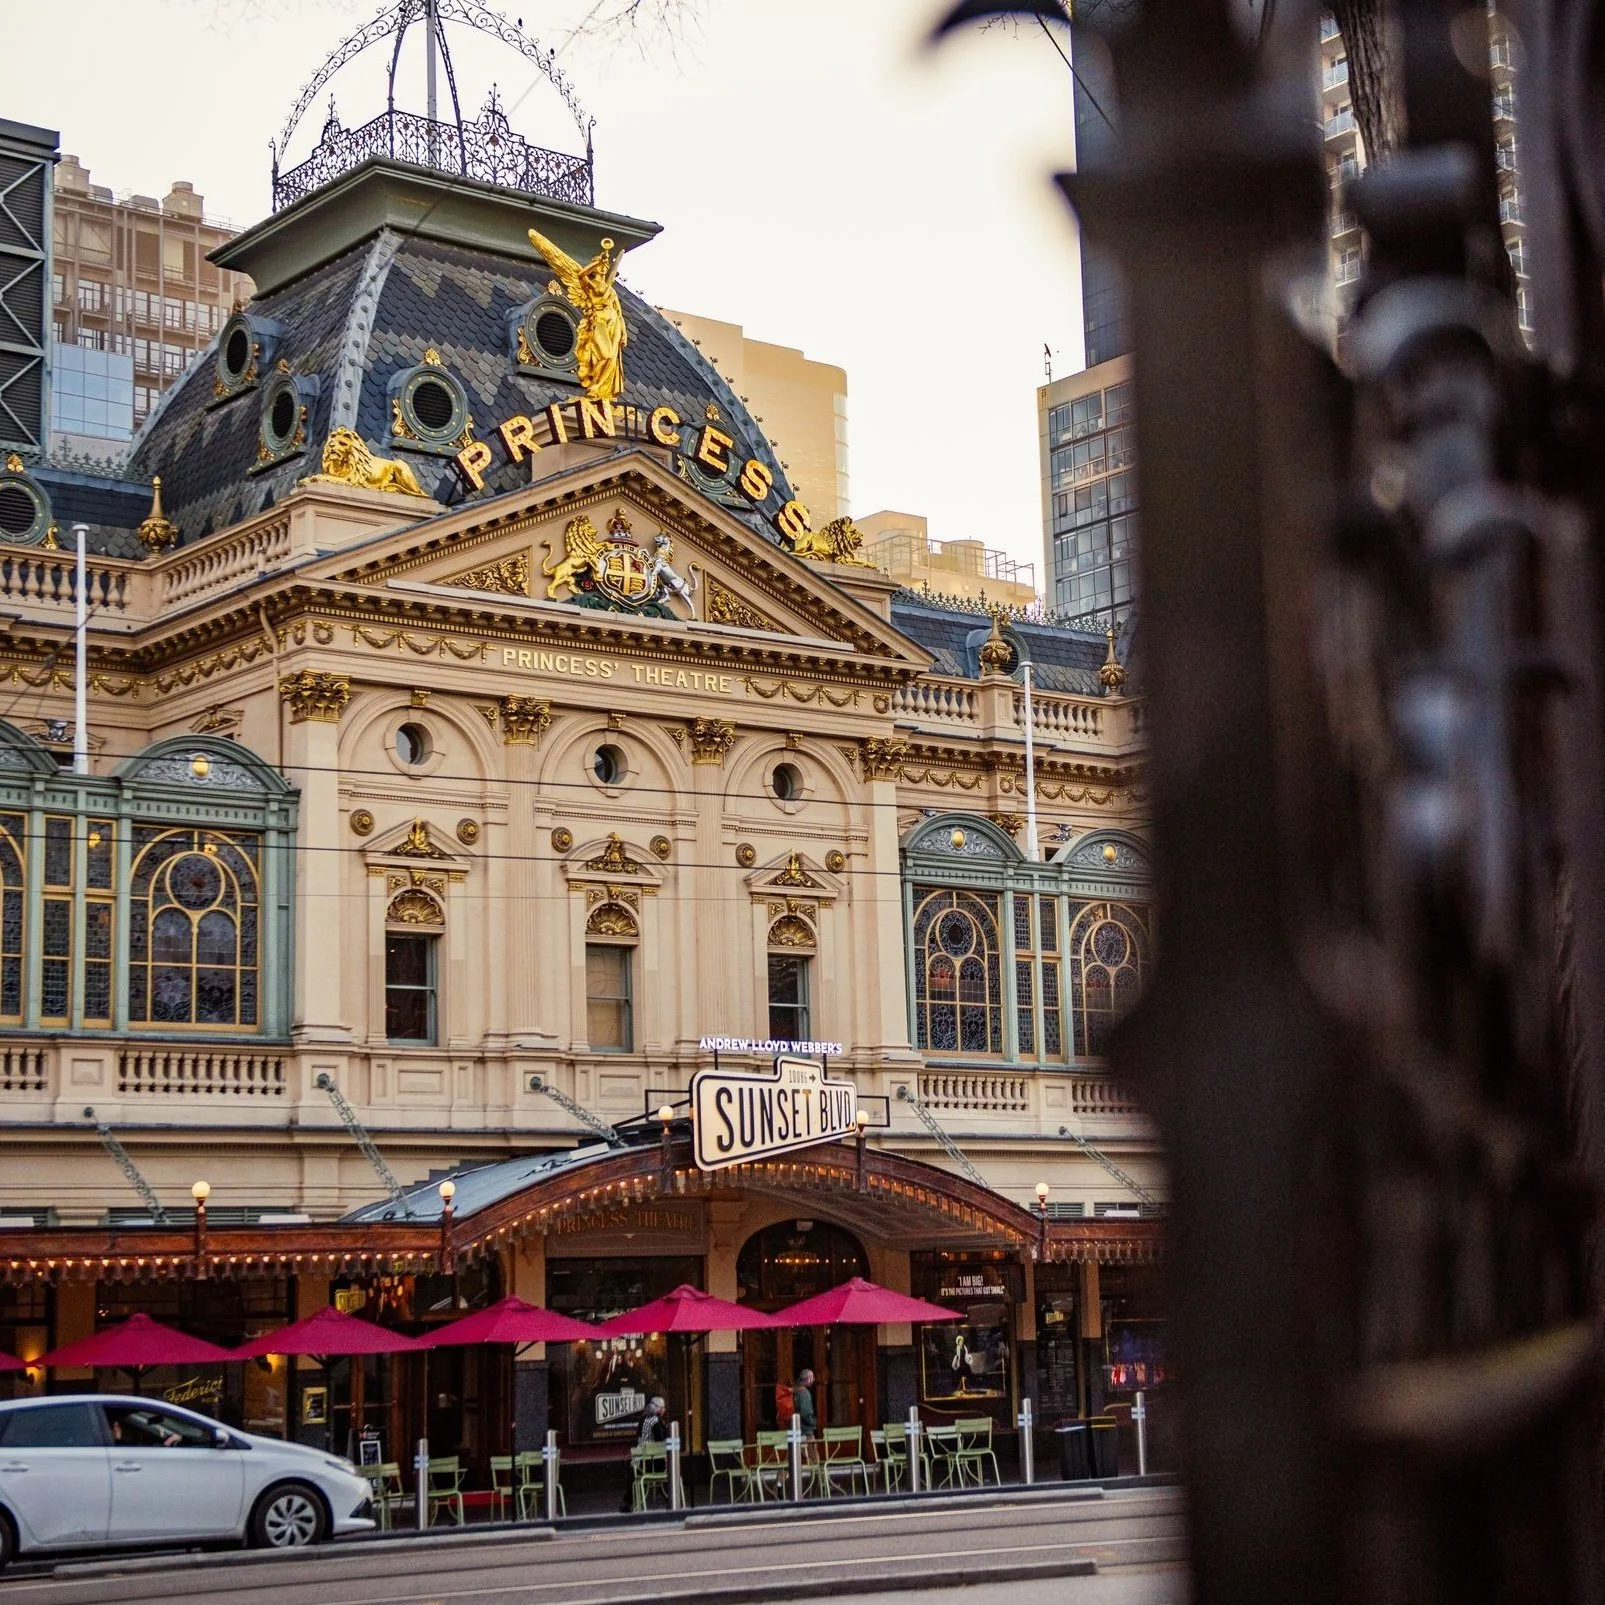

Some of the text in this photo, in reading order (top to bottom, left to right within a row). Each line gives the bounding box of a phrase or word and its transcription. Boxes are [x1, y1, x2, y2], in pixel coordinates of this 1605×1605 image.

[453, 397, 811, 542] PRINCESS
[630, 663, 733, 693] THEATRE
[699, 1037, 843, 1054] ANDREW LLOYD WEBBER'S
[715, 1087, 856, 1153] SUNSET BLVD.
[963, 1275, 971, 1286] AM
[602, 1396, 633, 1418] SUNSET
